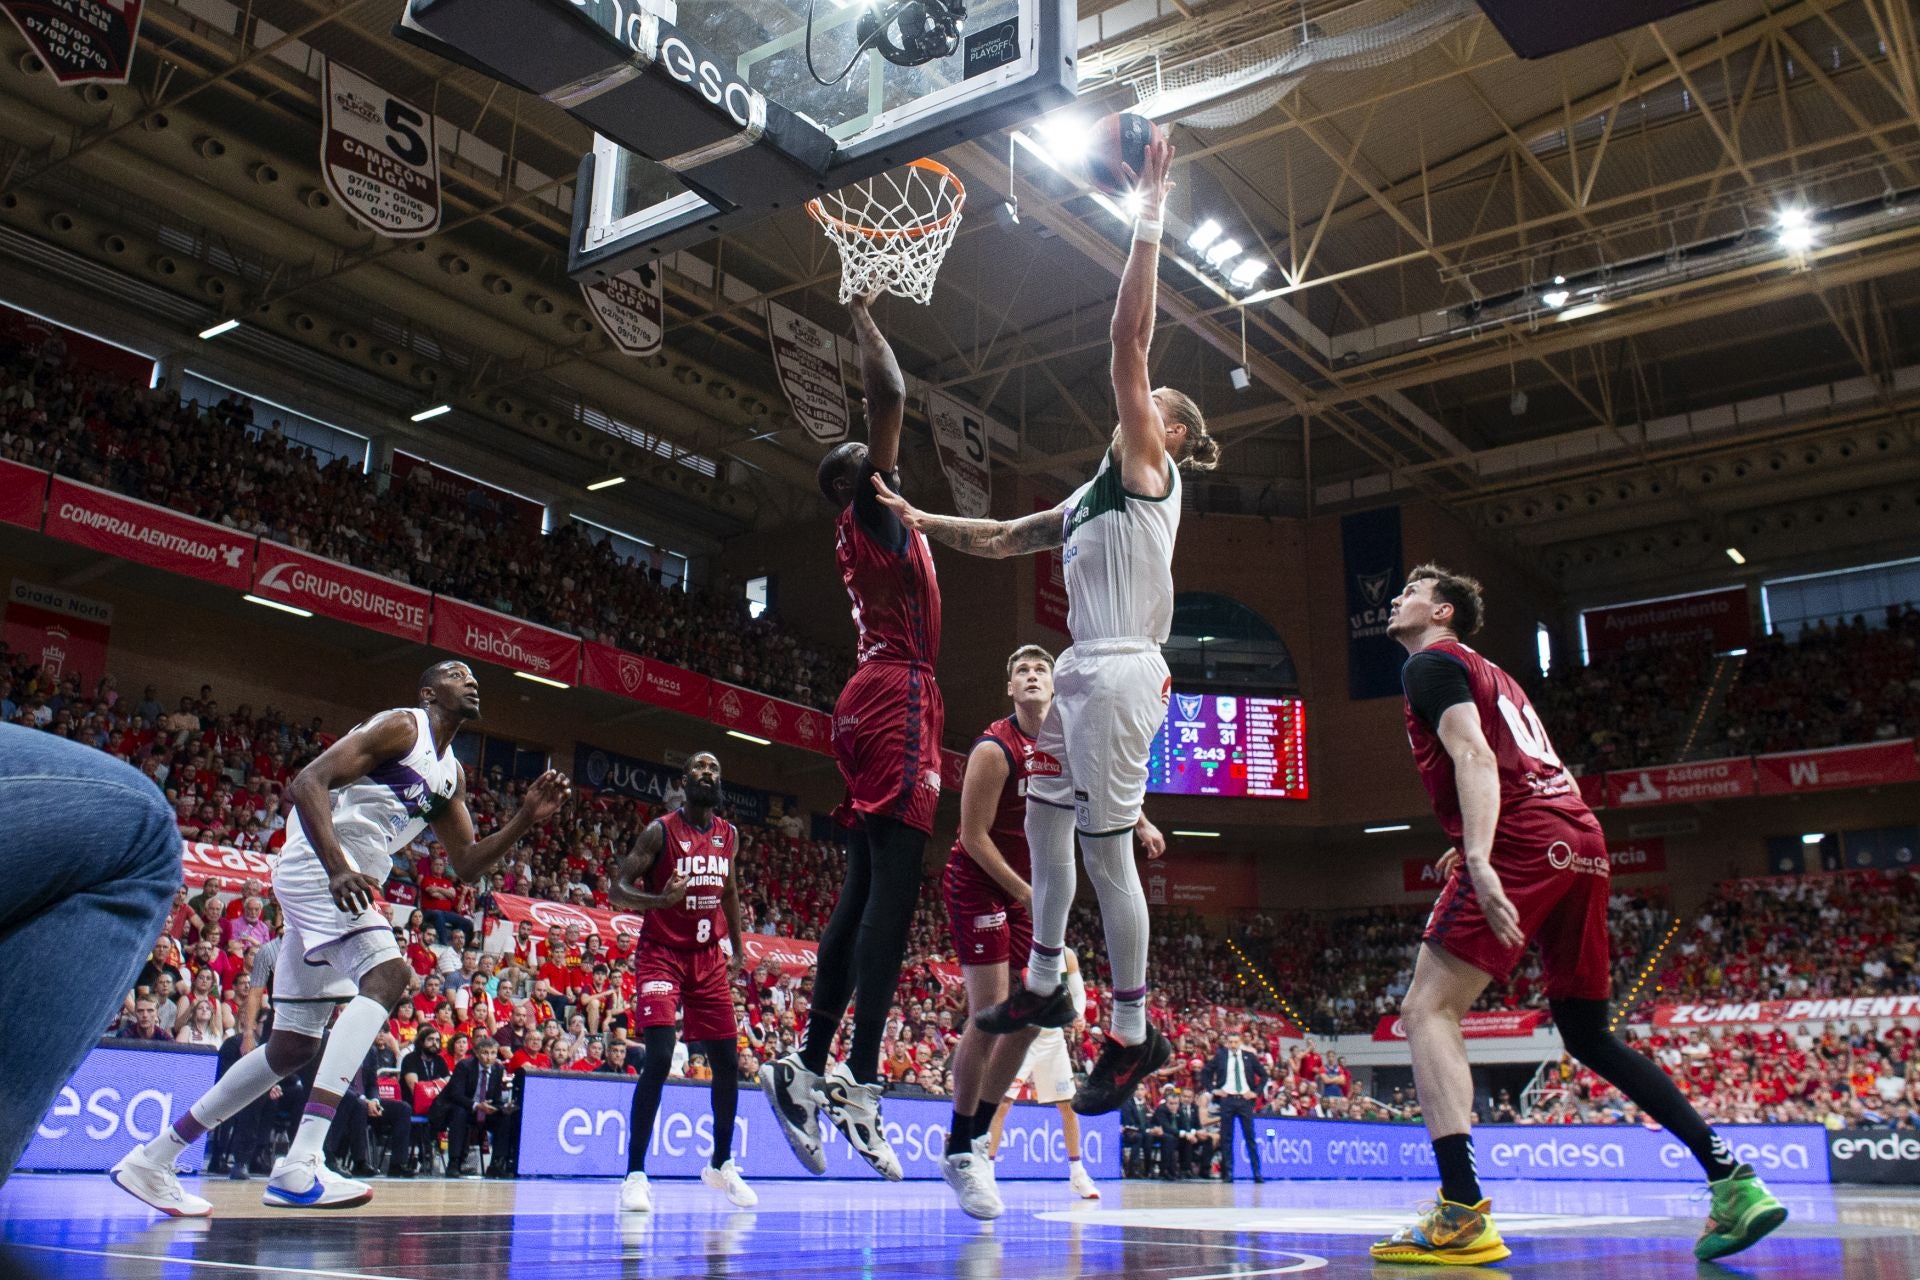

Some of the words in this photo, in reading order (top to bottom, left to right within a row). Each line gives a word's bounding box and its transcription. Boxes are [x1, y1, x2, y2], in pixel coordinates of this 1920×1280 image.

[26, 17, 67, 45] 97/98
[50, 18, 90, 44] 89/90
[48, 42, 86, 69] 10/11
[970, 39, 1009, 62] PLAYOFF
[384, 98, 428, 167] 5
[342, 139, 427, 190] CAMPEÓN
[366, 162, 407, 190] LIGA
[371, 206, 402, 225] 09/10
[606, 287, 643, 312] COPA
[963, 415, 985, 463] 5
[60, 503, 217, 562] COMPRALAENTRADA
[15, 585, 63, 607] Grada
[68, 599, 108, 618] Norte
[291, 570, 424, 628] GRUPOSURESTE
[1180, 728, 1199, 743] 24
[1220, 730, 1236, 745] 31
[1193, 747, 1226, 761] 2:43
[1666, 780, 1741, 799] Partners
[676, 855, 729, 877] UCAM
[686, 875, 724, 888] MURCIA
[696, 918, 711, 943] 8
[1669, 1001, 1761, 1024] ZONA
[1327, 1135, 1389, 1165] endesa
[1490, 1138, 1625, 1168] endesa
